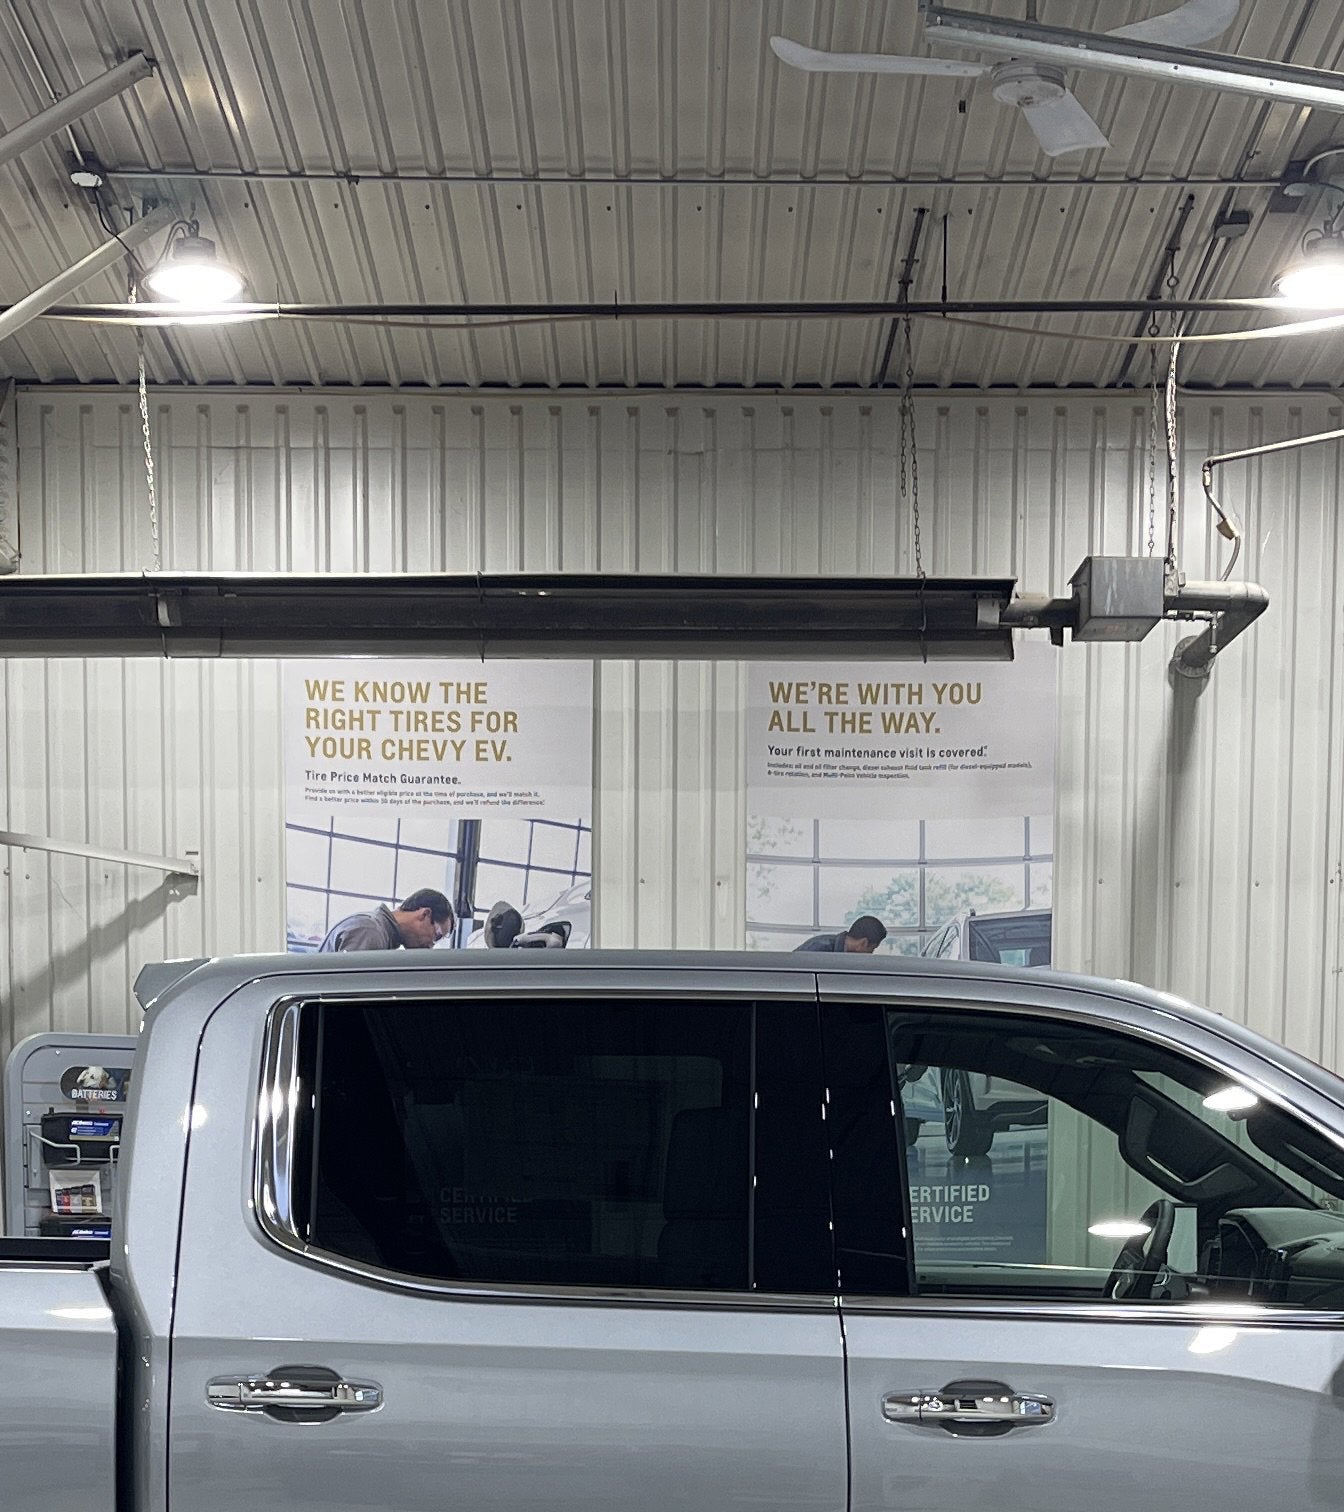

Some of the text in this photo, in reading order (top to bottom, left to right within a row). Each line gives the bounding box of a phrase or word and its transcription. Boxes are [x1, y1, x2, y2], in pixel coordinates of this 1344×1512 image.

[305, 680, 488, 704] WE KNOW THE
[768, 681, 982, 705] WE’RE WITH YOU
[305, 707, 518, 733] RIGHT TIRES FOR
[768, 710, 940, 734] ALL THE WAY.
[305, 736, 512, 762] YOUR CHEVY EV.
[768, 745, 793, 756] Your
[796, 746, 821, 757] first
[825, 748, 896, 758] maintenance
[900, 747, 923, 758] visit
[927, 748, 936, 758] is
[305, 770, 461, 784] Tire Price Match Guarantee.
[72, 1089, 117, 1100] BATTERIES
[910, 1184, 990, 1202] ERTIFIED
[440, 1207, 518, 1224] SERVICE
[911, 1206, 974, 1222] ERVICE
